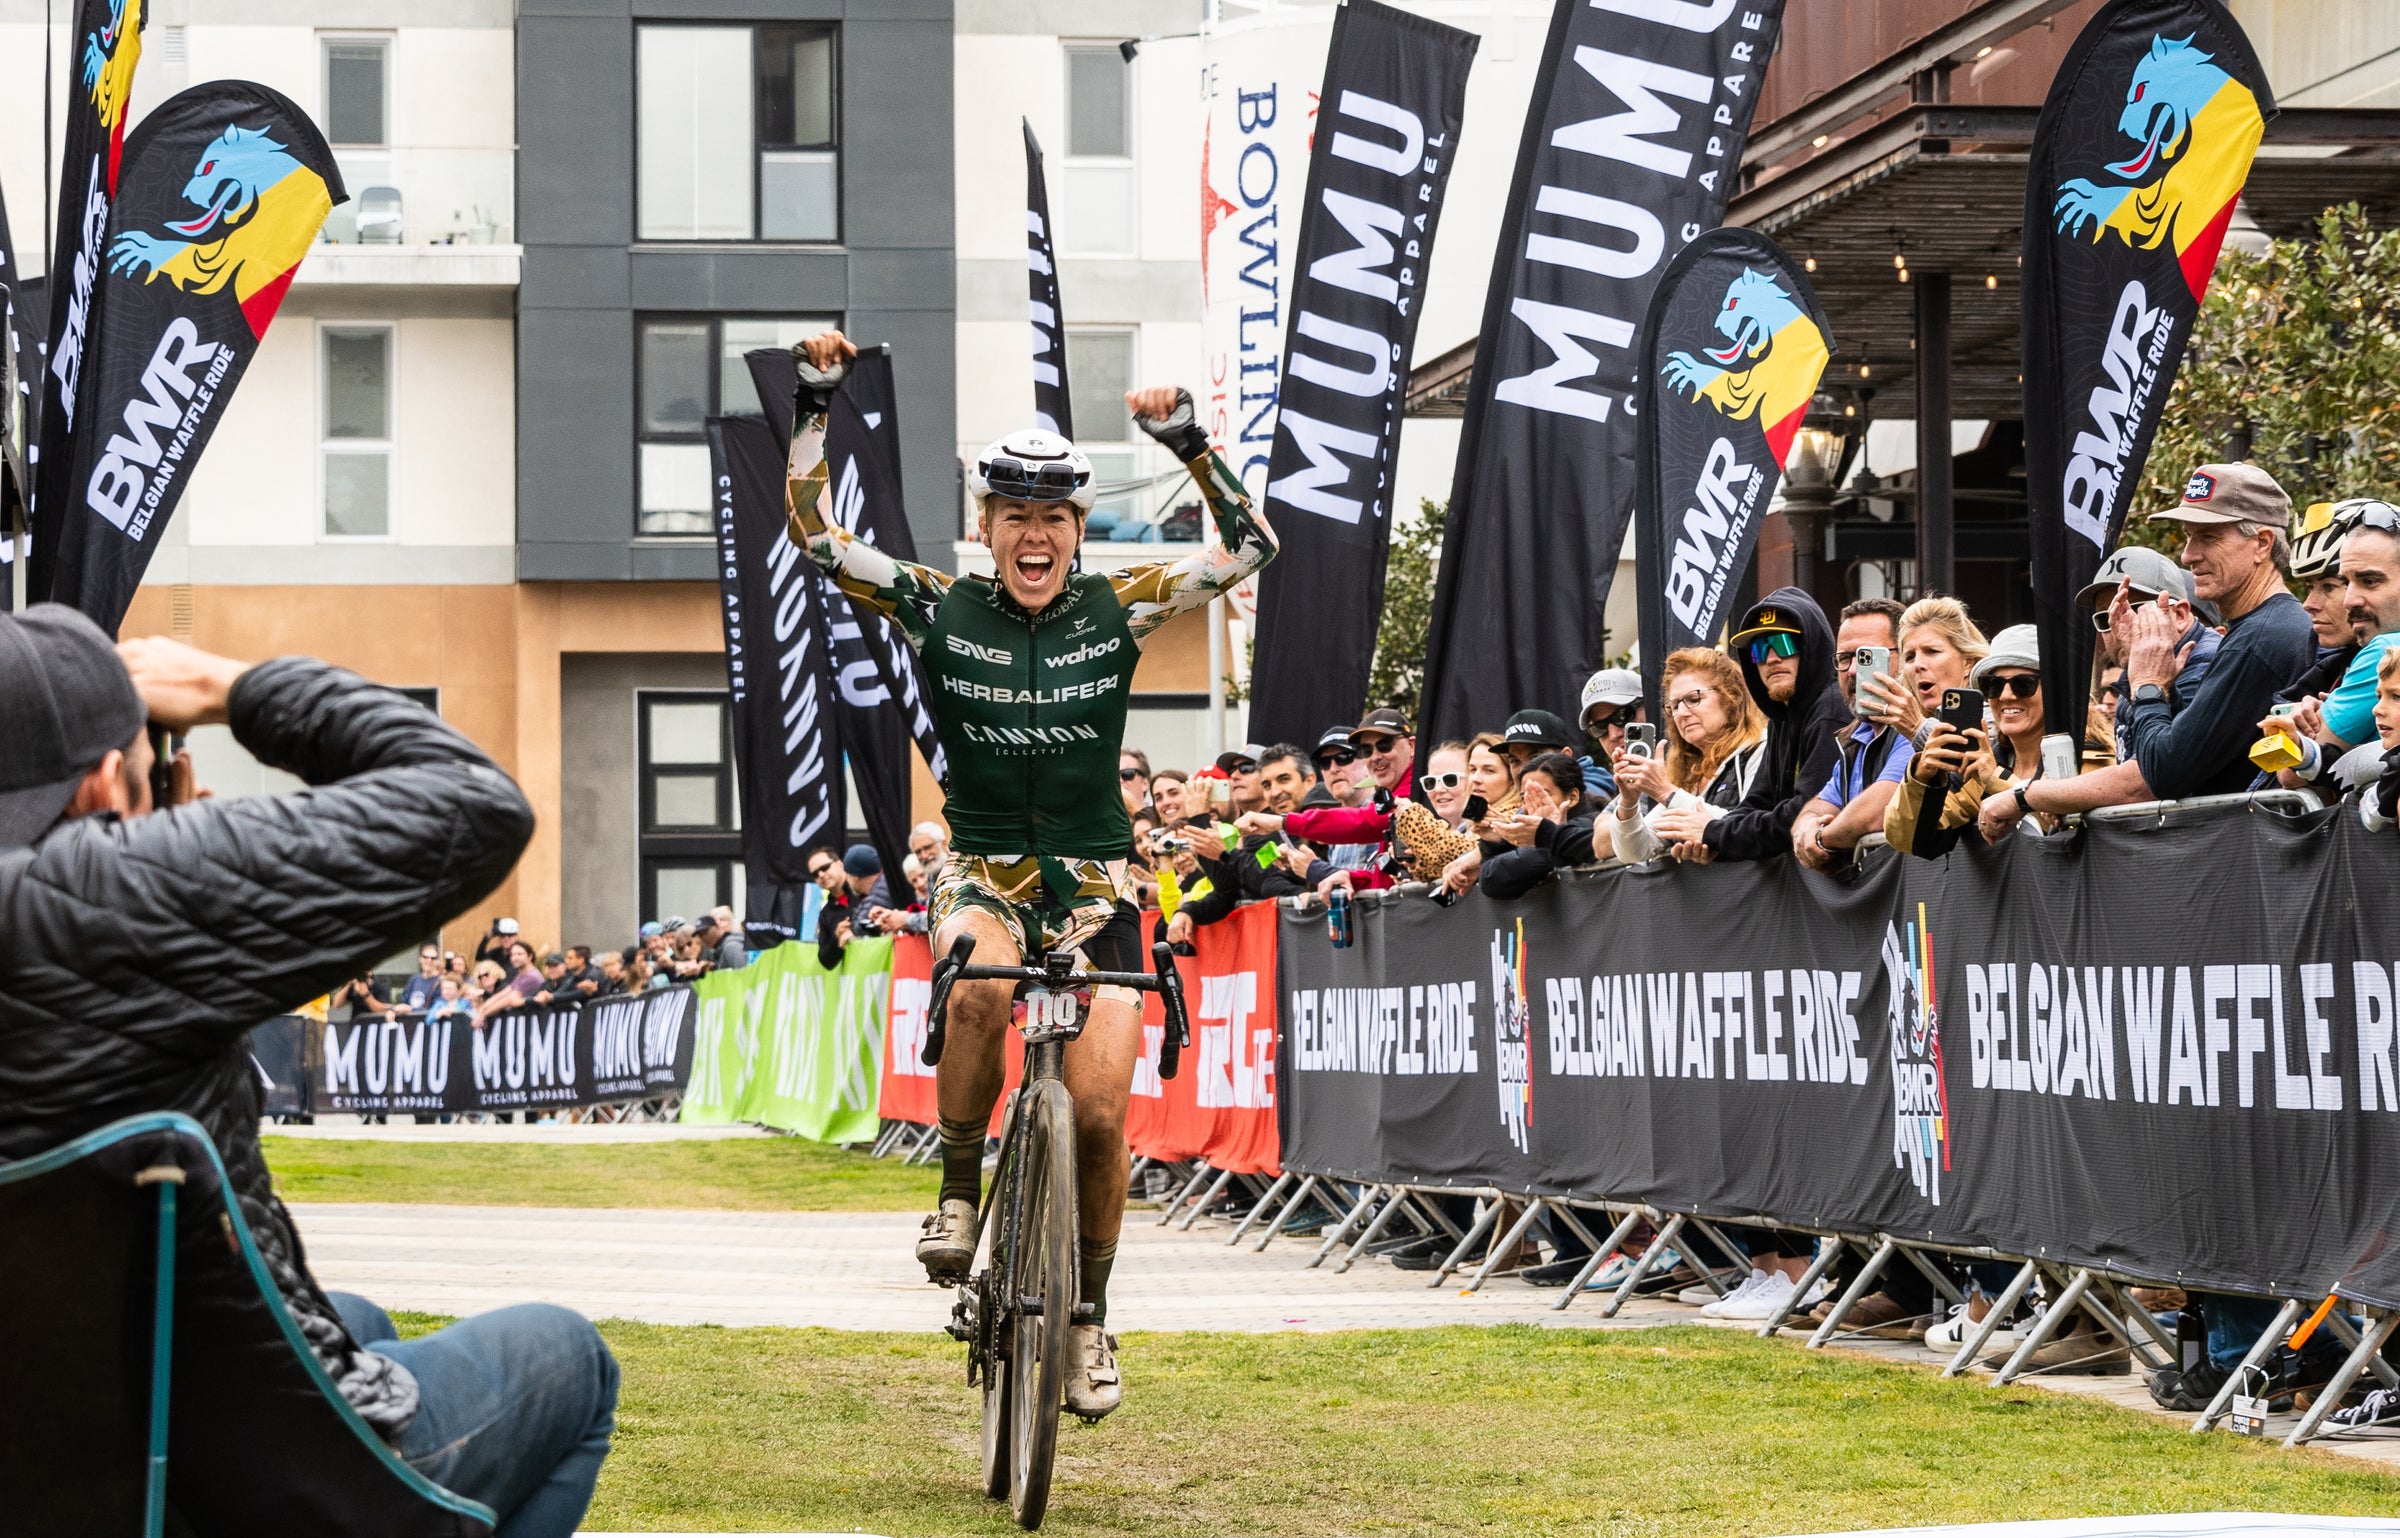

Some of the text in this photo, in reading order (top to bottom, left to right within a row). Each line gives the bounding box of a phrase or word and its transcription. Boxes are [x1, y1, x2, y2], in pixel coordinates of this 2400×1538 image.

[1698, 11, 1763, 192] APPARE
[1397, 132, 1445, 317] APPAREL
[1267, 89, 1425, 525] MUMU
[87, 316, 219, 532] BWR
[126, 343, 236, 542] BELGIAN WAFFLE RIDE
[2063, 280, 2161, 549] BWR
[2119, 362, 2157, 459] WAFFLE
[2147, 308, 2175, 366] RIDE
[718, 475, 746, 703] CYCLING APPAREL
[1664, 436, 1754, 630] BWR
[1693, 467, 1765, 641] BELGIAN WAFFLE RIDE
[1044, 637, 1121, 668] wahoo
[962, 721, 1099, 745] CANYON
[323, 1021, 452, 1095] MUMU
[471, 1011, 579, 1090] MUMU
[1024, 992, 1078, 1027] 110
[1293, 987, 1357, 1071] BELGIAN
[1357, 986, 1424, 1075] WAFFLE
[1427, 980, 1479, 1074] RIDE
[1501, 1042, 1529, 1084] BWR
[1545, 968, 1869, 1085] BELGIAN WAFFLE RIDE
[1965, 962, 2116, 1101] BELGIAN
[2122, 964, 2343, 1110] WAFFLE
[332, 1096, 445, 1109] CYCLING APPAREL
[480, 1088, 579, 1105] CYCLING APPAREL
[1898, 1063, 1940, 1117] BWR
